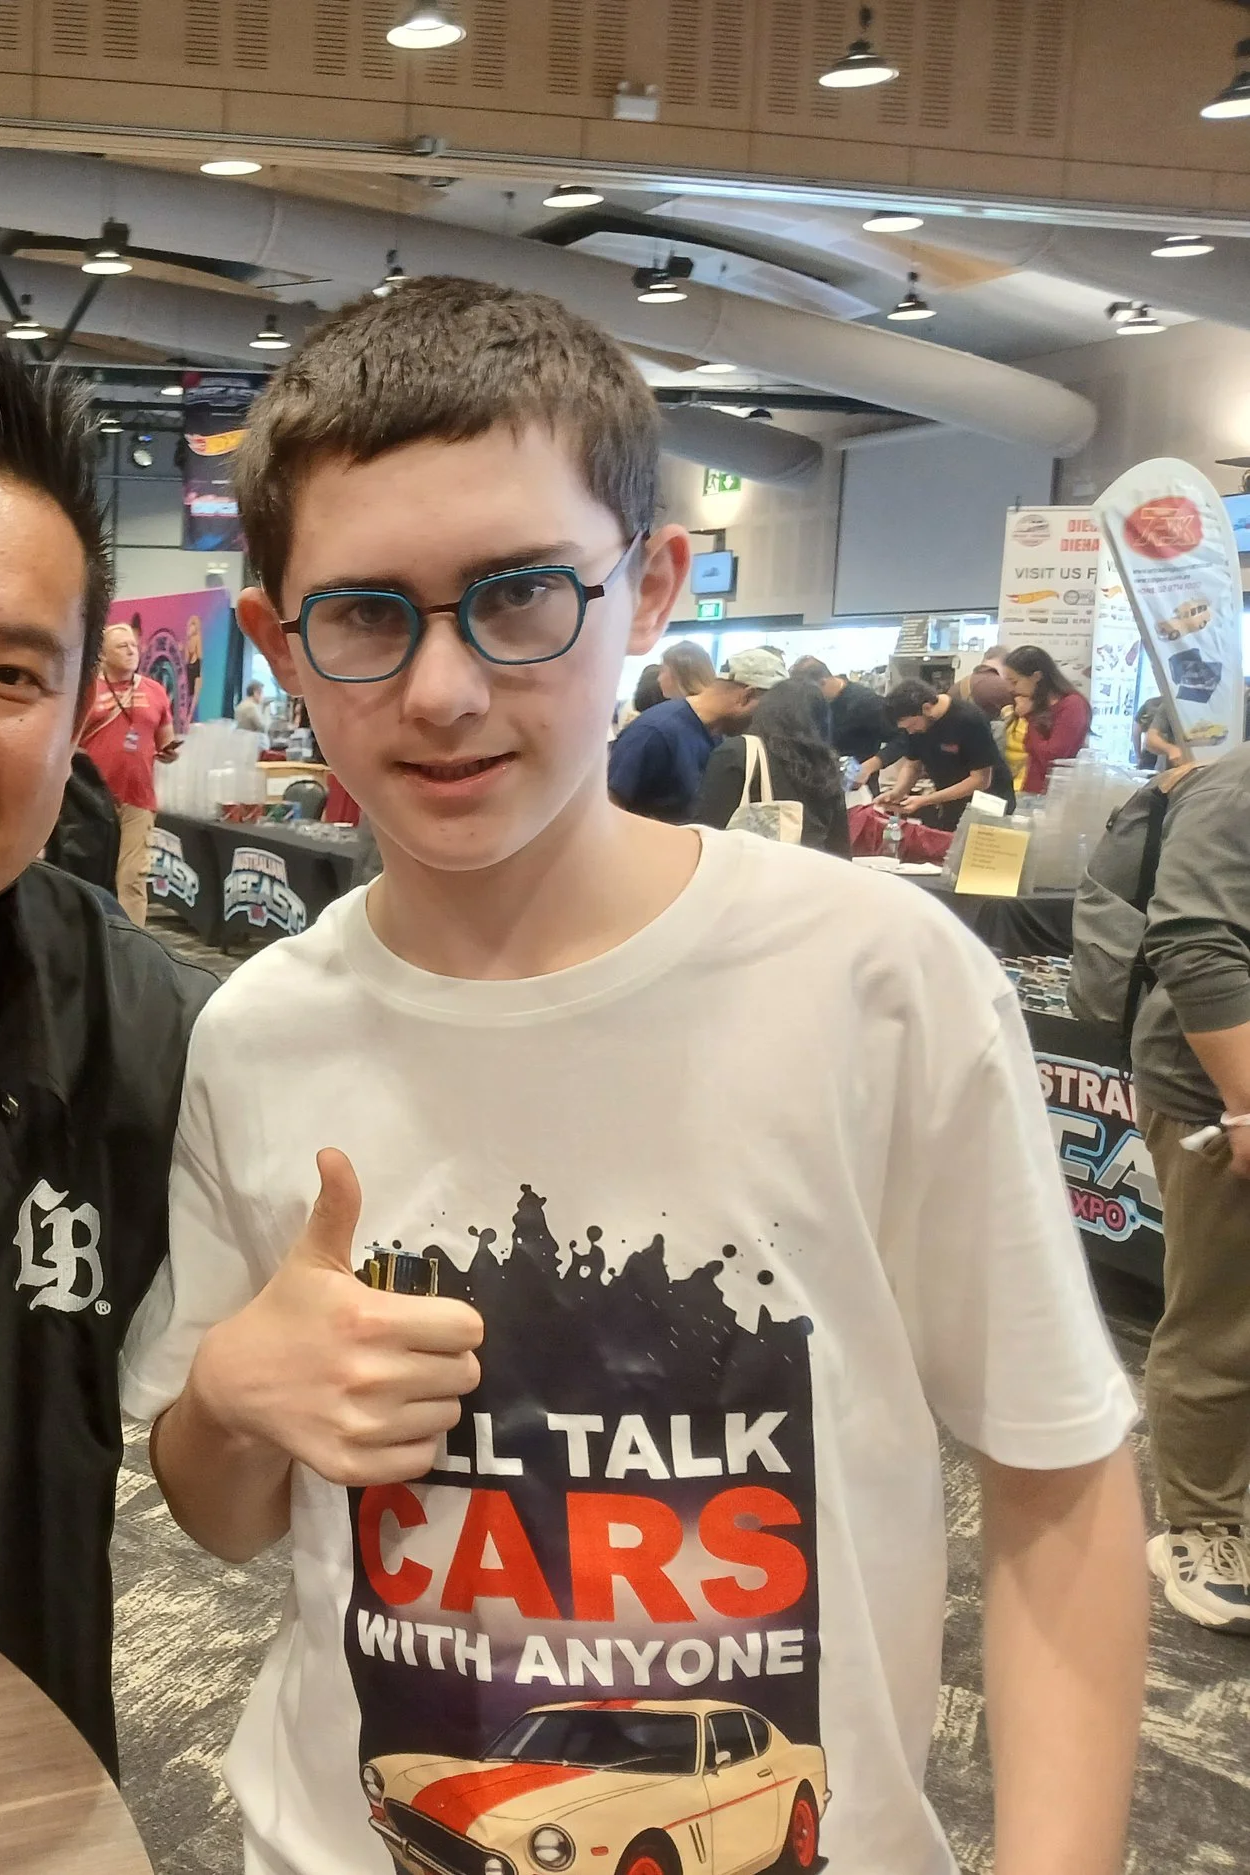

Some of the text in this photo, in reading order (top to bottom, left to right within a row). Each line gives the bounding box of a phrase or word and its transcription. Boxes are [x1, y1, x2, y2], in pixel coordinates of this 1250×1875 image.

[1014, 567, 1055, 580] VISIT
[1059, 567, 1082, 580] US
[1069, 1189, 1127, 1233] XPO
[433, 1411, 792, 1480] LL TALK
[357, 1485, 808, 1624] CARS
[357, 1608, 805, 1688] WITH ANYONE
